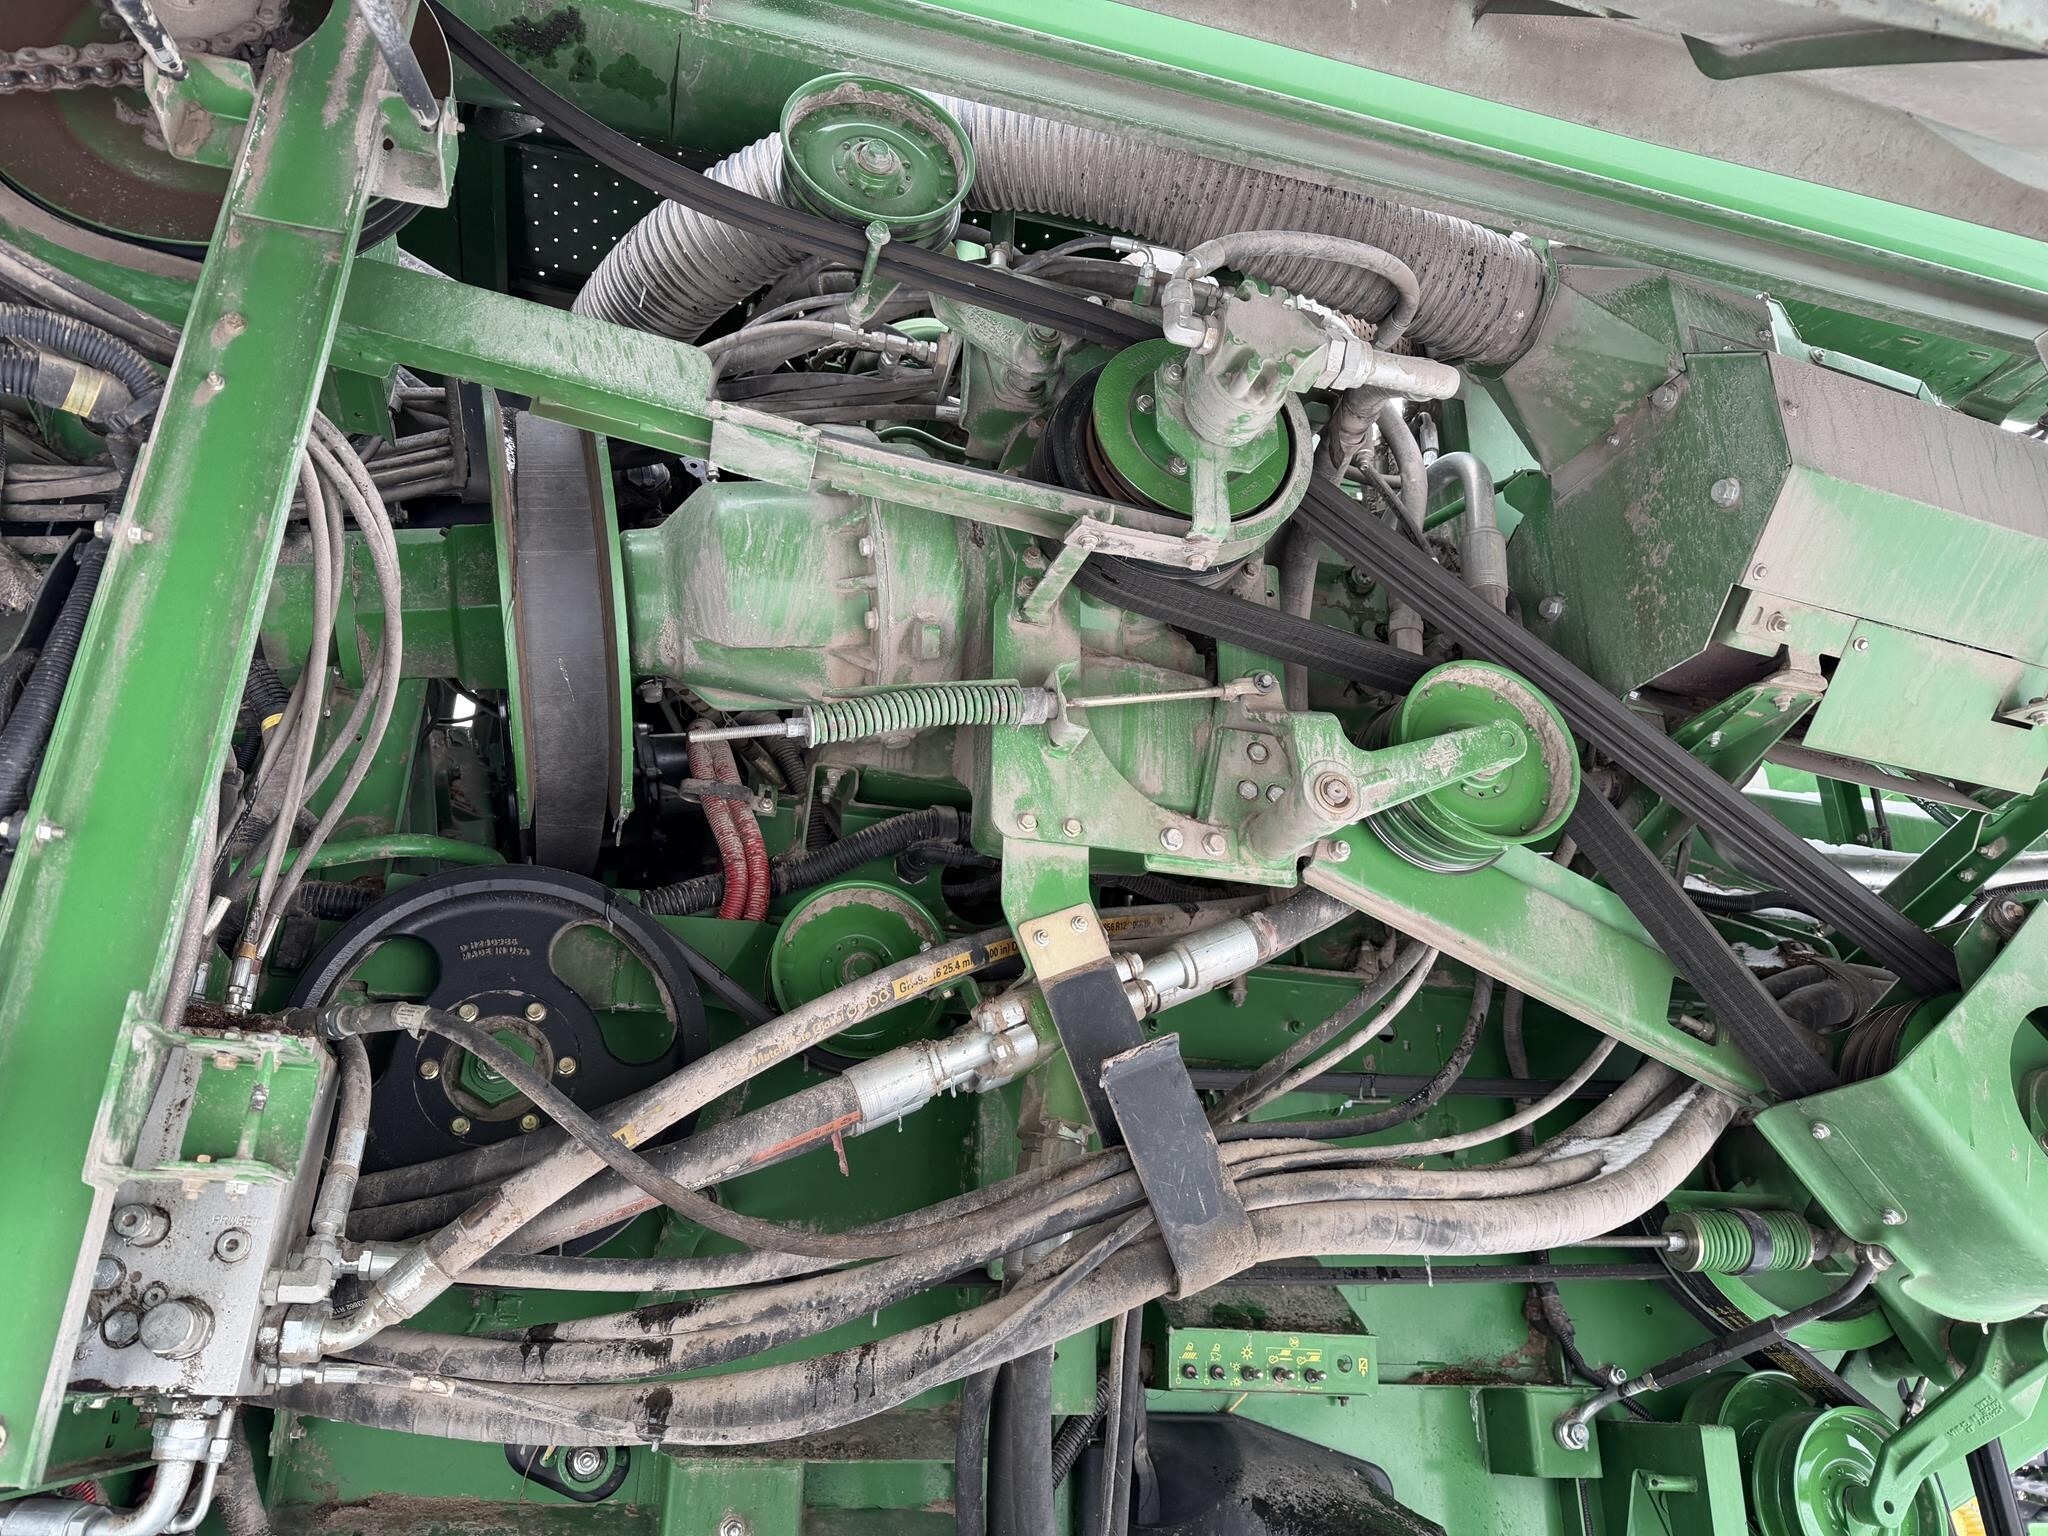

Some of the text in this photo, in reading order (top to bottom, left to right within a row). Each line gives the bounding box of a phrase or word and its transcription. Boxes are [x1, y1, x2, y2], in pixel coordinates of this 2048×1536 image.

[462, 948, 492, 960] MADE
[942, 960, 961, 975] 25.4
[812, 1010, 846, 1036] Global
